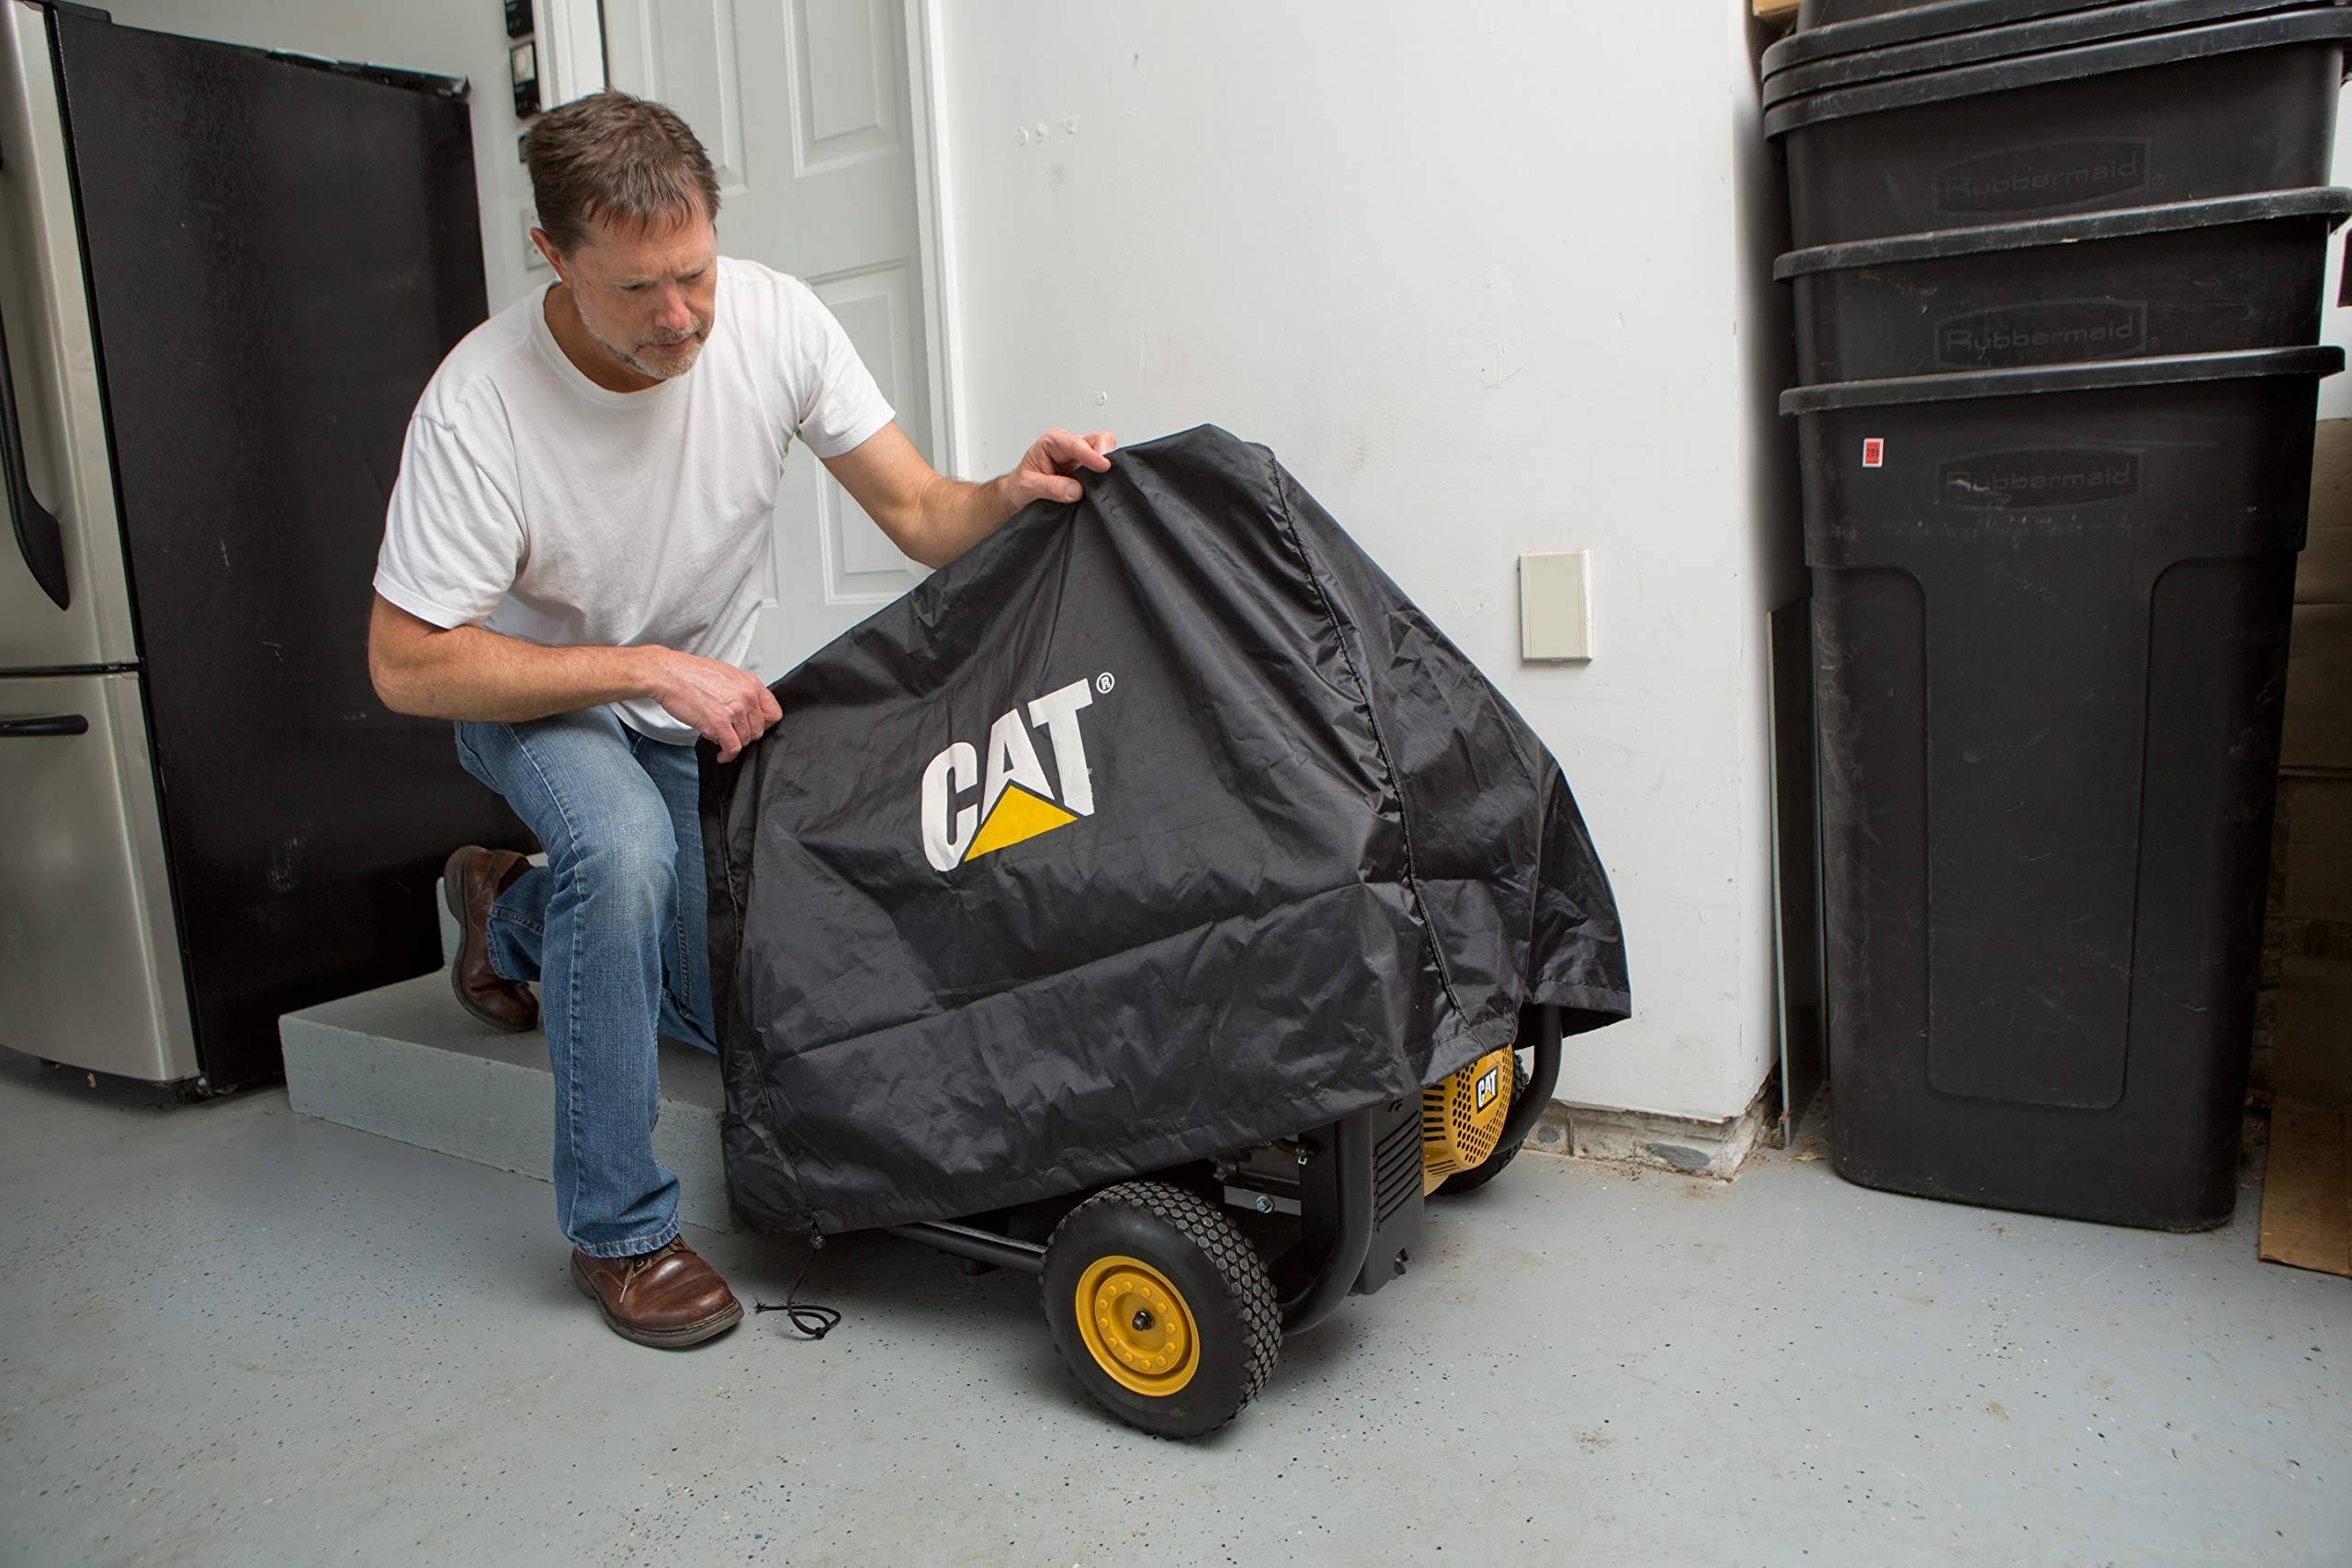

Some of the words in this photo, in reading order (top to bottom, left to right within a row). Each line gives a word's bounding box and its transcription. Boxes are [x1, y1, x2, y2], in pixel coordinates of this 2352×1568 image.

[1946, 152, 2137, 197] Rubbermaid
[1947, 315, 2133, 353] Rubbermaid
[922, 678, 1094, 872] CAT
[1478, 1069, 1497, 1108] CAT
